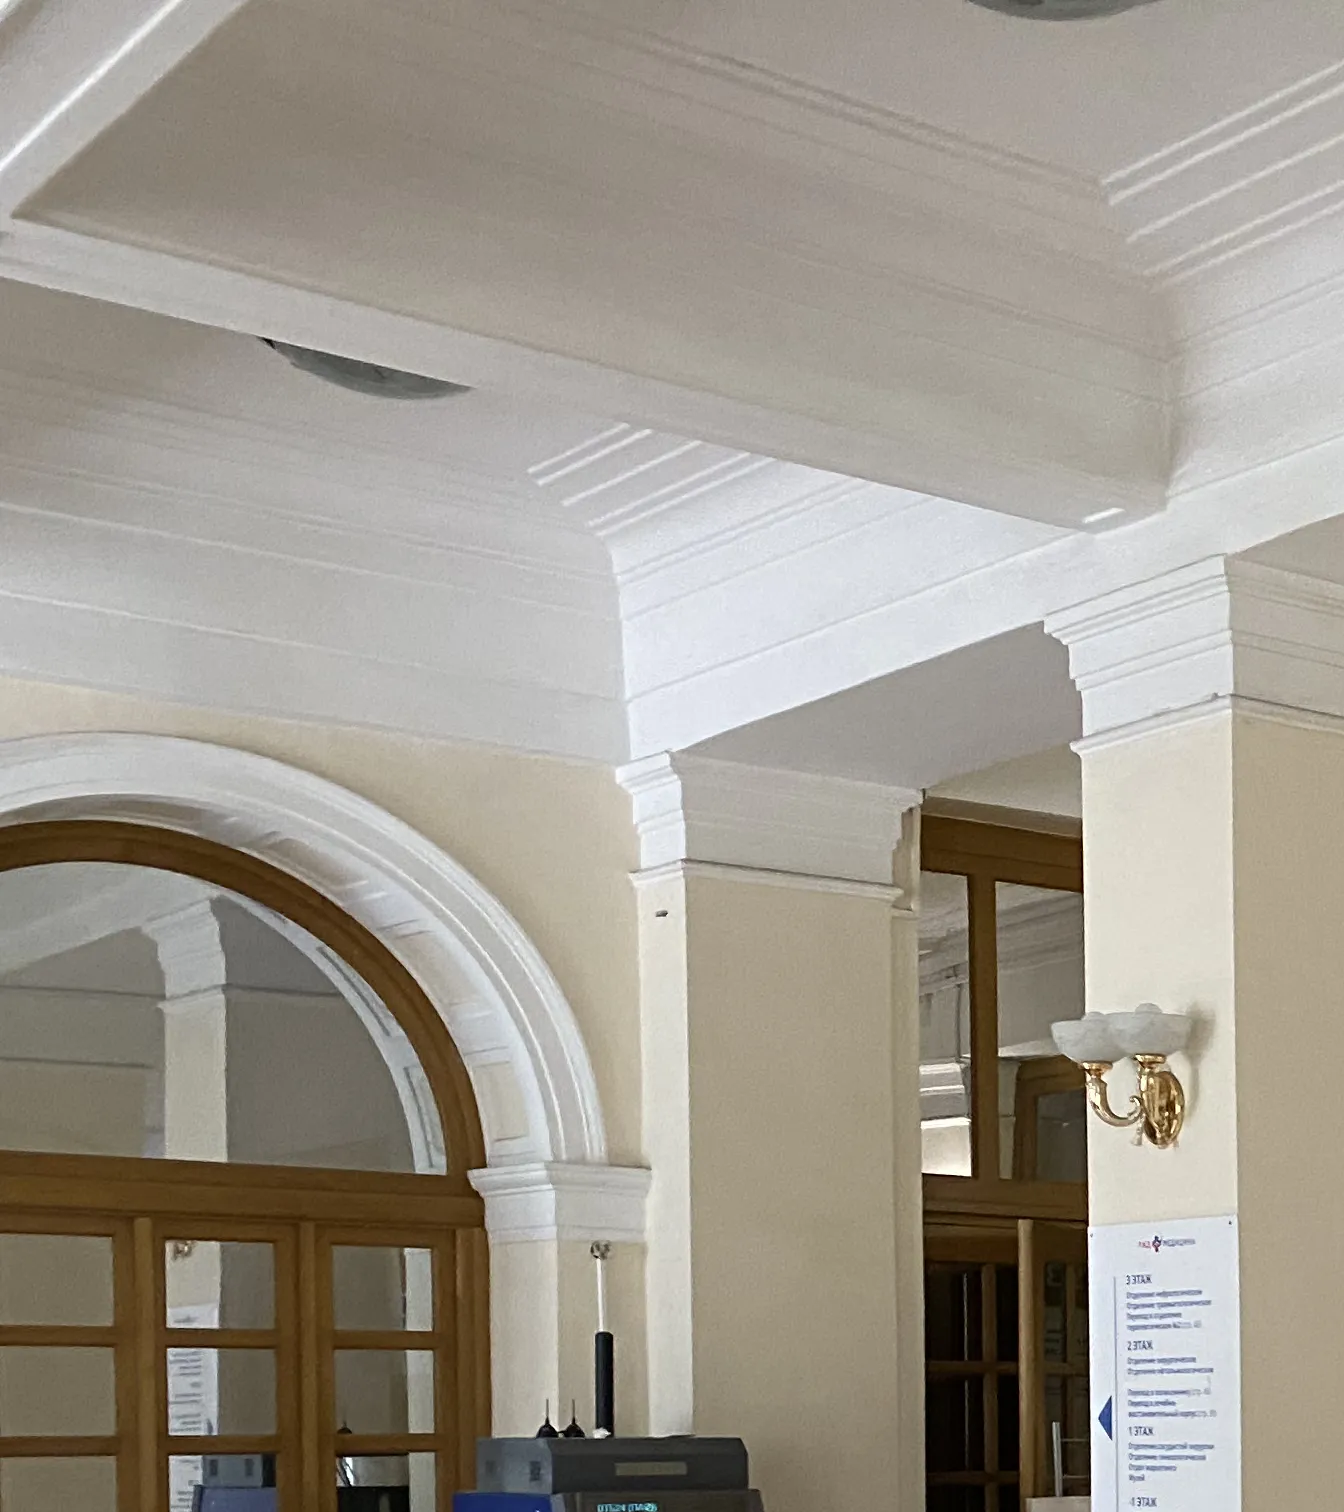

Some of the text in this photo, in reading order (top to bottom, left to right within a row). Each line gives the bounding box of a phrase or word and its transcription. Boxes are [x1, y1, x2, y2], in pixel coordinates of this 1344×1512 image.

[1126, 1274, 1152, 1286] 3 ЭТАЖ
[1127, 1340, 1154, 1351] 2 ЭТАЖ
[1133, 1426, 1154, 1437] ЭТАЖ
[1136, 1496, 1157, 1508] ЭТАЖ
